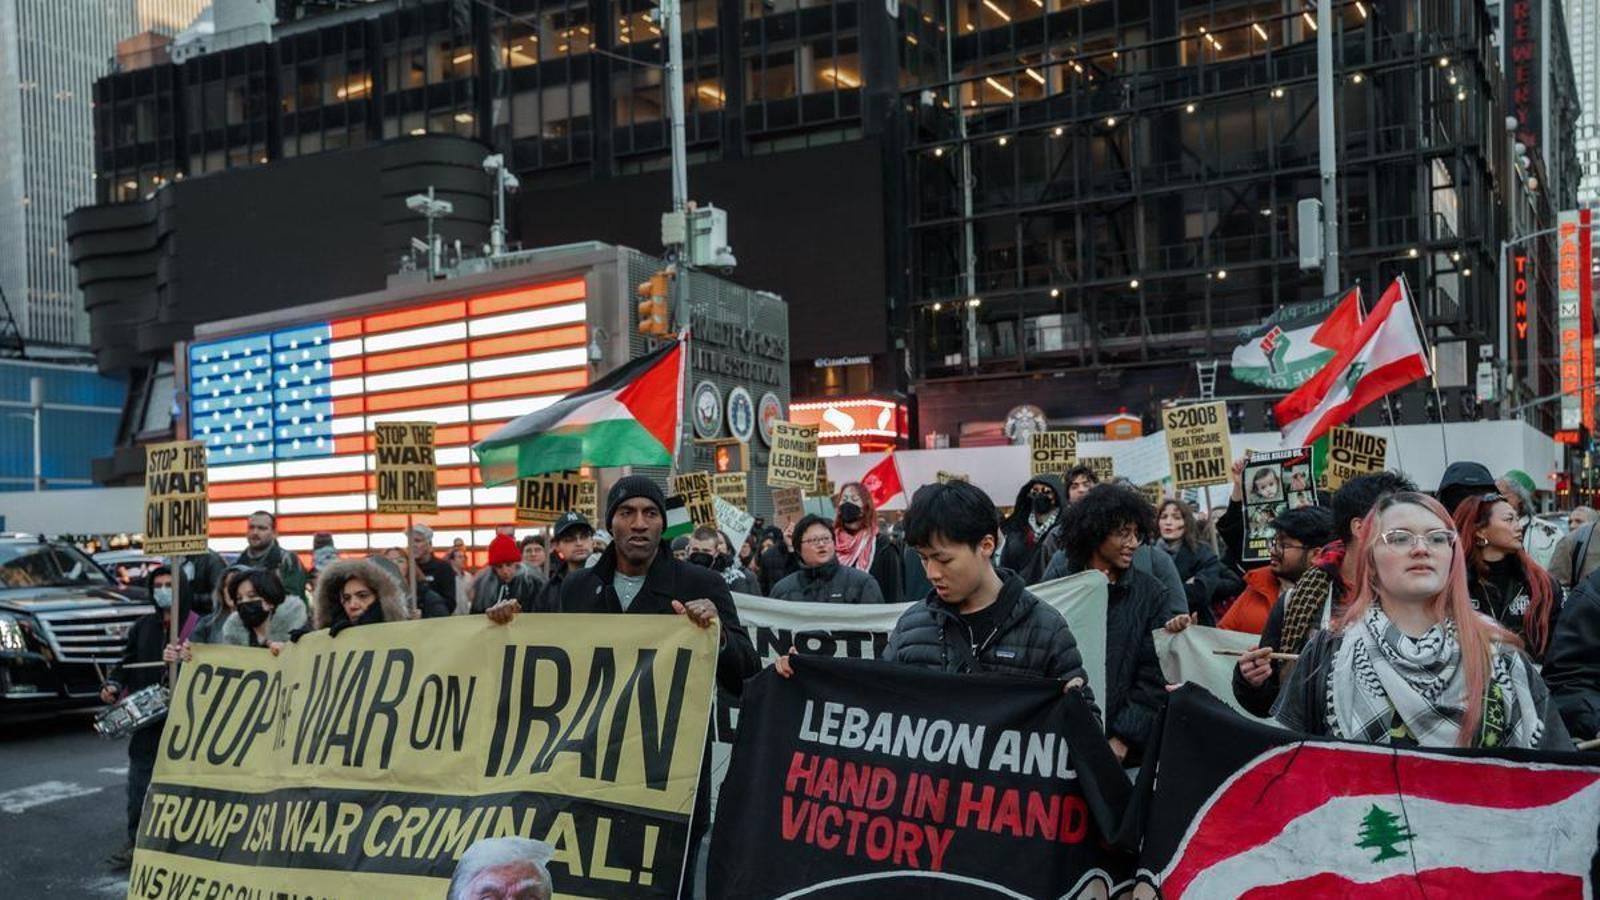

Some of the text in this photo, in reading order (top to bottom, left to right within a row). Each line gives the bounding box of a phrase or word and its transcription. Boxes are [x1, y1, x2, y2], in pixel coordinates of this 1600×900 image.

[1560, 222, 1577, 291] PARK
[1514, 256, 1528, 339] TONY
[1168, 405, 1217, 429] $200B
[377, 425, 432, 446] STOP THE
[777, 424, 819, 438] STOP
[1033, 433, 1076, 449] HANDS
[1172, 432, 1221, 448] HEALTHCARE
[1333, 428, 1387, 457] HANDS
[149, 445, 205, 472] STOP THE
[377, 446, 432, 465] WAR
[772, 452, 817, 472] LEBANON
[1033, 449, 1077, 461] OFF
[1192, 447, 1211, 459] WAR
[1332, 447, 1385, 471] OFF
[1175, 458, 1226, 482] IRAN!
[149, 472, 205, 495] WAR
[379, 470, 398, 501] ON
[519, 479, 579, 512] IRAN!
[147, 498, 206, 538] ON IRAN!
[690, 502, 715, 525] AN!
[167, 663, 282, 767] STOP
[292, 648, 415, 770] WAR
[409, 672, 477, 752] ON
[484, 644, 693, 792] IRAN
[798, 699, 987, 771] LEBANON
[785, 751, 1089, 846] HAND IN HAND
[144, 793, 250, 849] TRUMP
[280, 800, 364, 855] WAR
[780, 796, 956, 873] VICTORY
